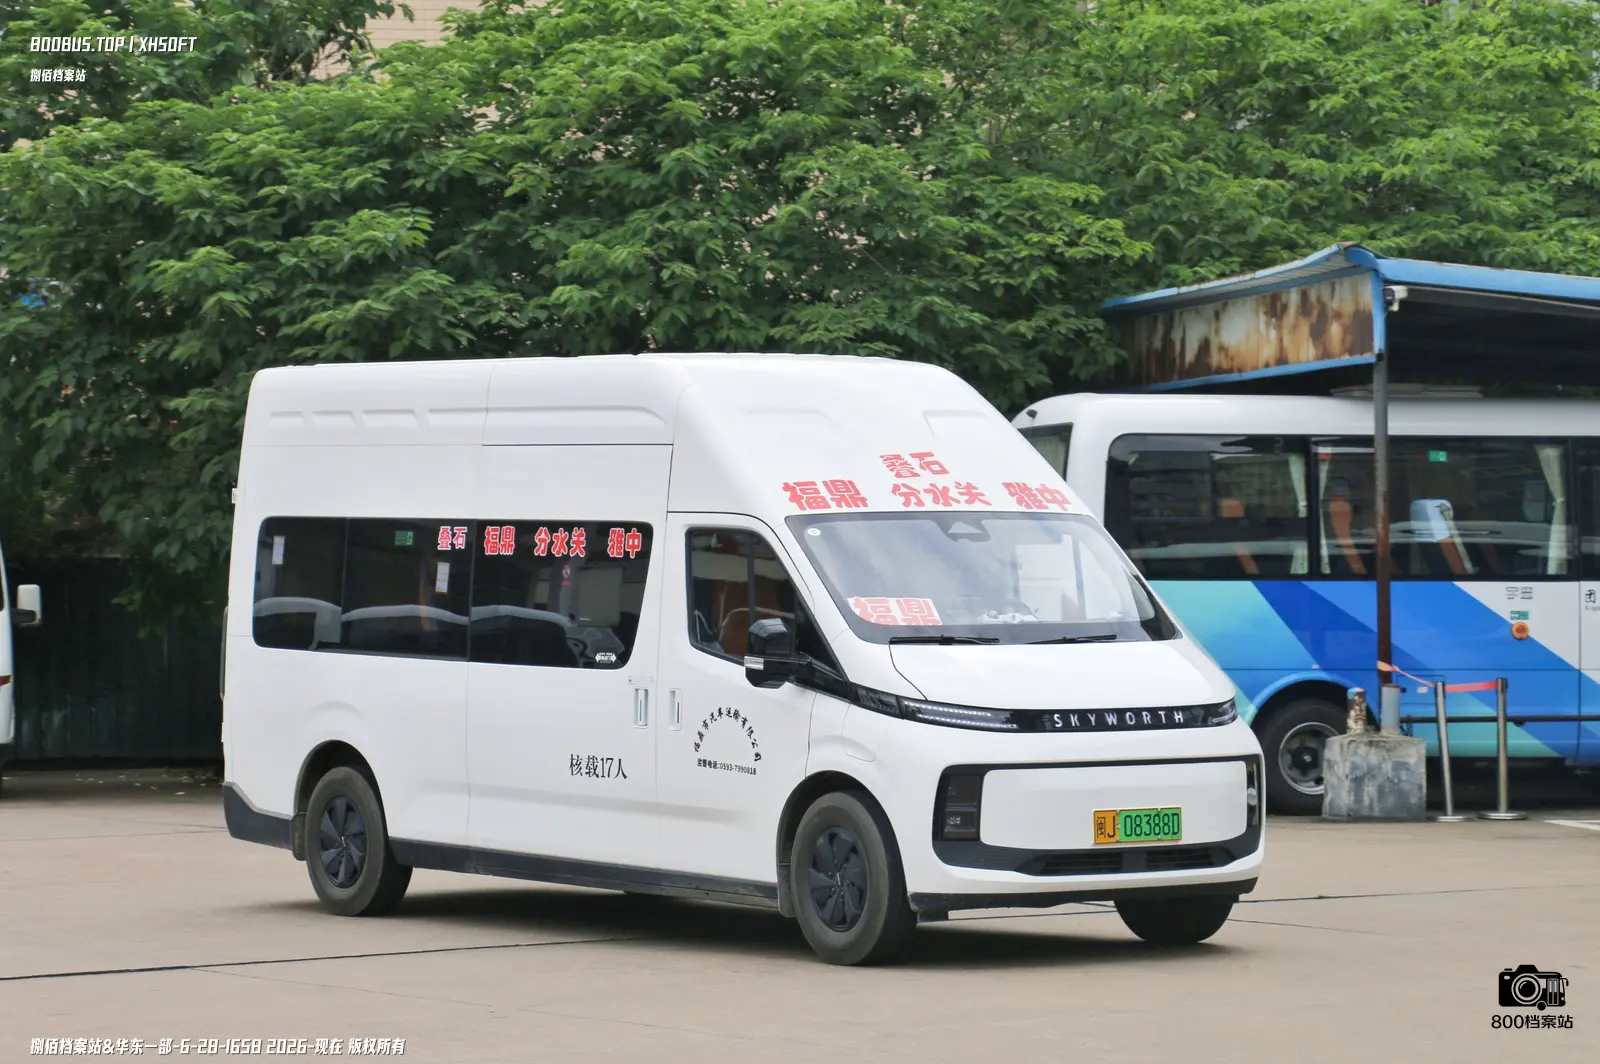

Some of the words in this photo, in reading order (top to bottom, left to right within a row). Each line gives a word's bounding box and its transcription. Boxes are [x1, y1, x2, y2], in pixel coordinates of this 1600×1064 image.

[880, 451, 950, 479] 叠石
[782, 479, 868, 511] 福鼎
[891, 481, 992, 508] 分水关
[1002, 482, 1072, 511] 雅中
[437, 526, 468, 551] 叠石
[484, 525, 516, 556] 福鼎
[534, 526, 587, 558] 分水关
[607, 528, 642, 558] 雅中
[853, 598, 942, 626] 福鼎
[1053, 709, 1185, 729] SKYWORTH
[569, 753, 628, 780] 核载17人
